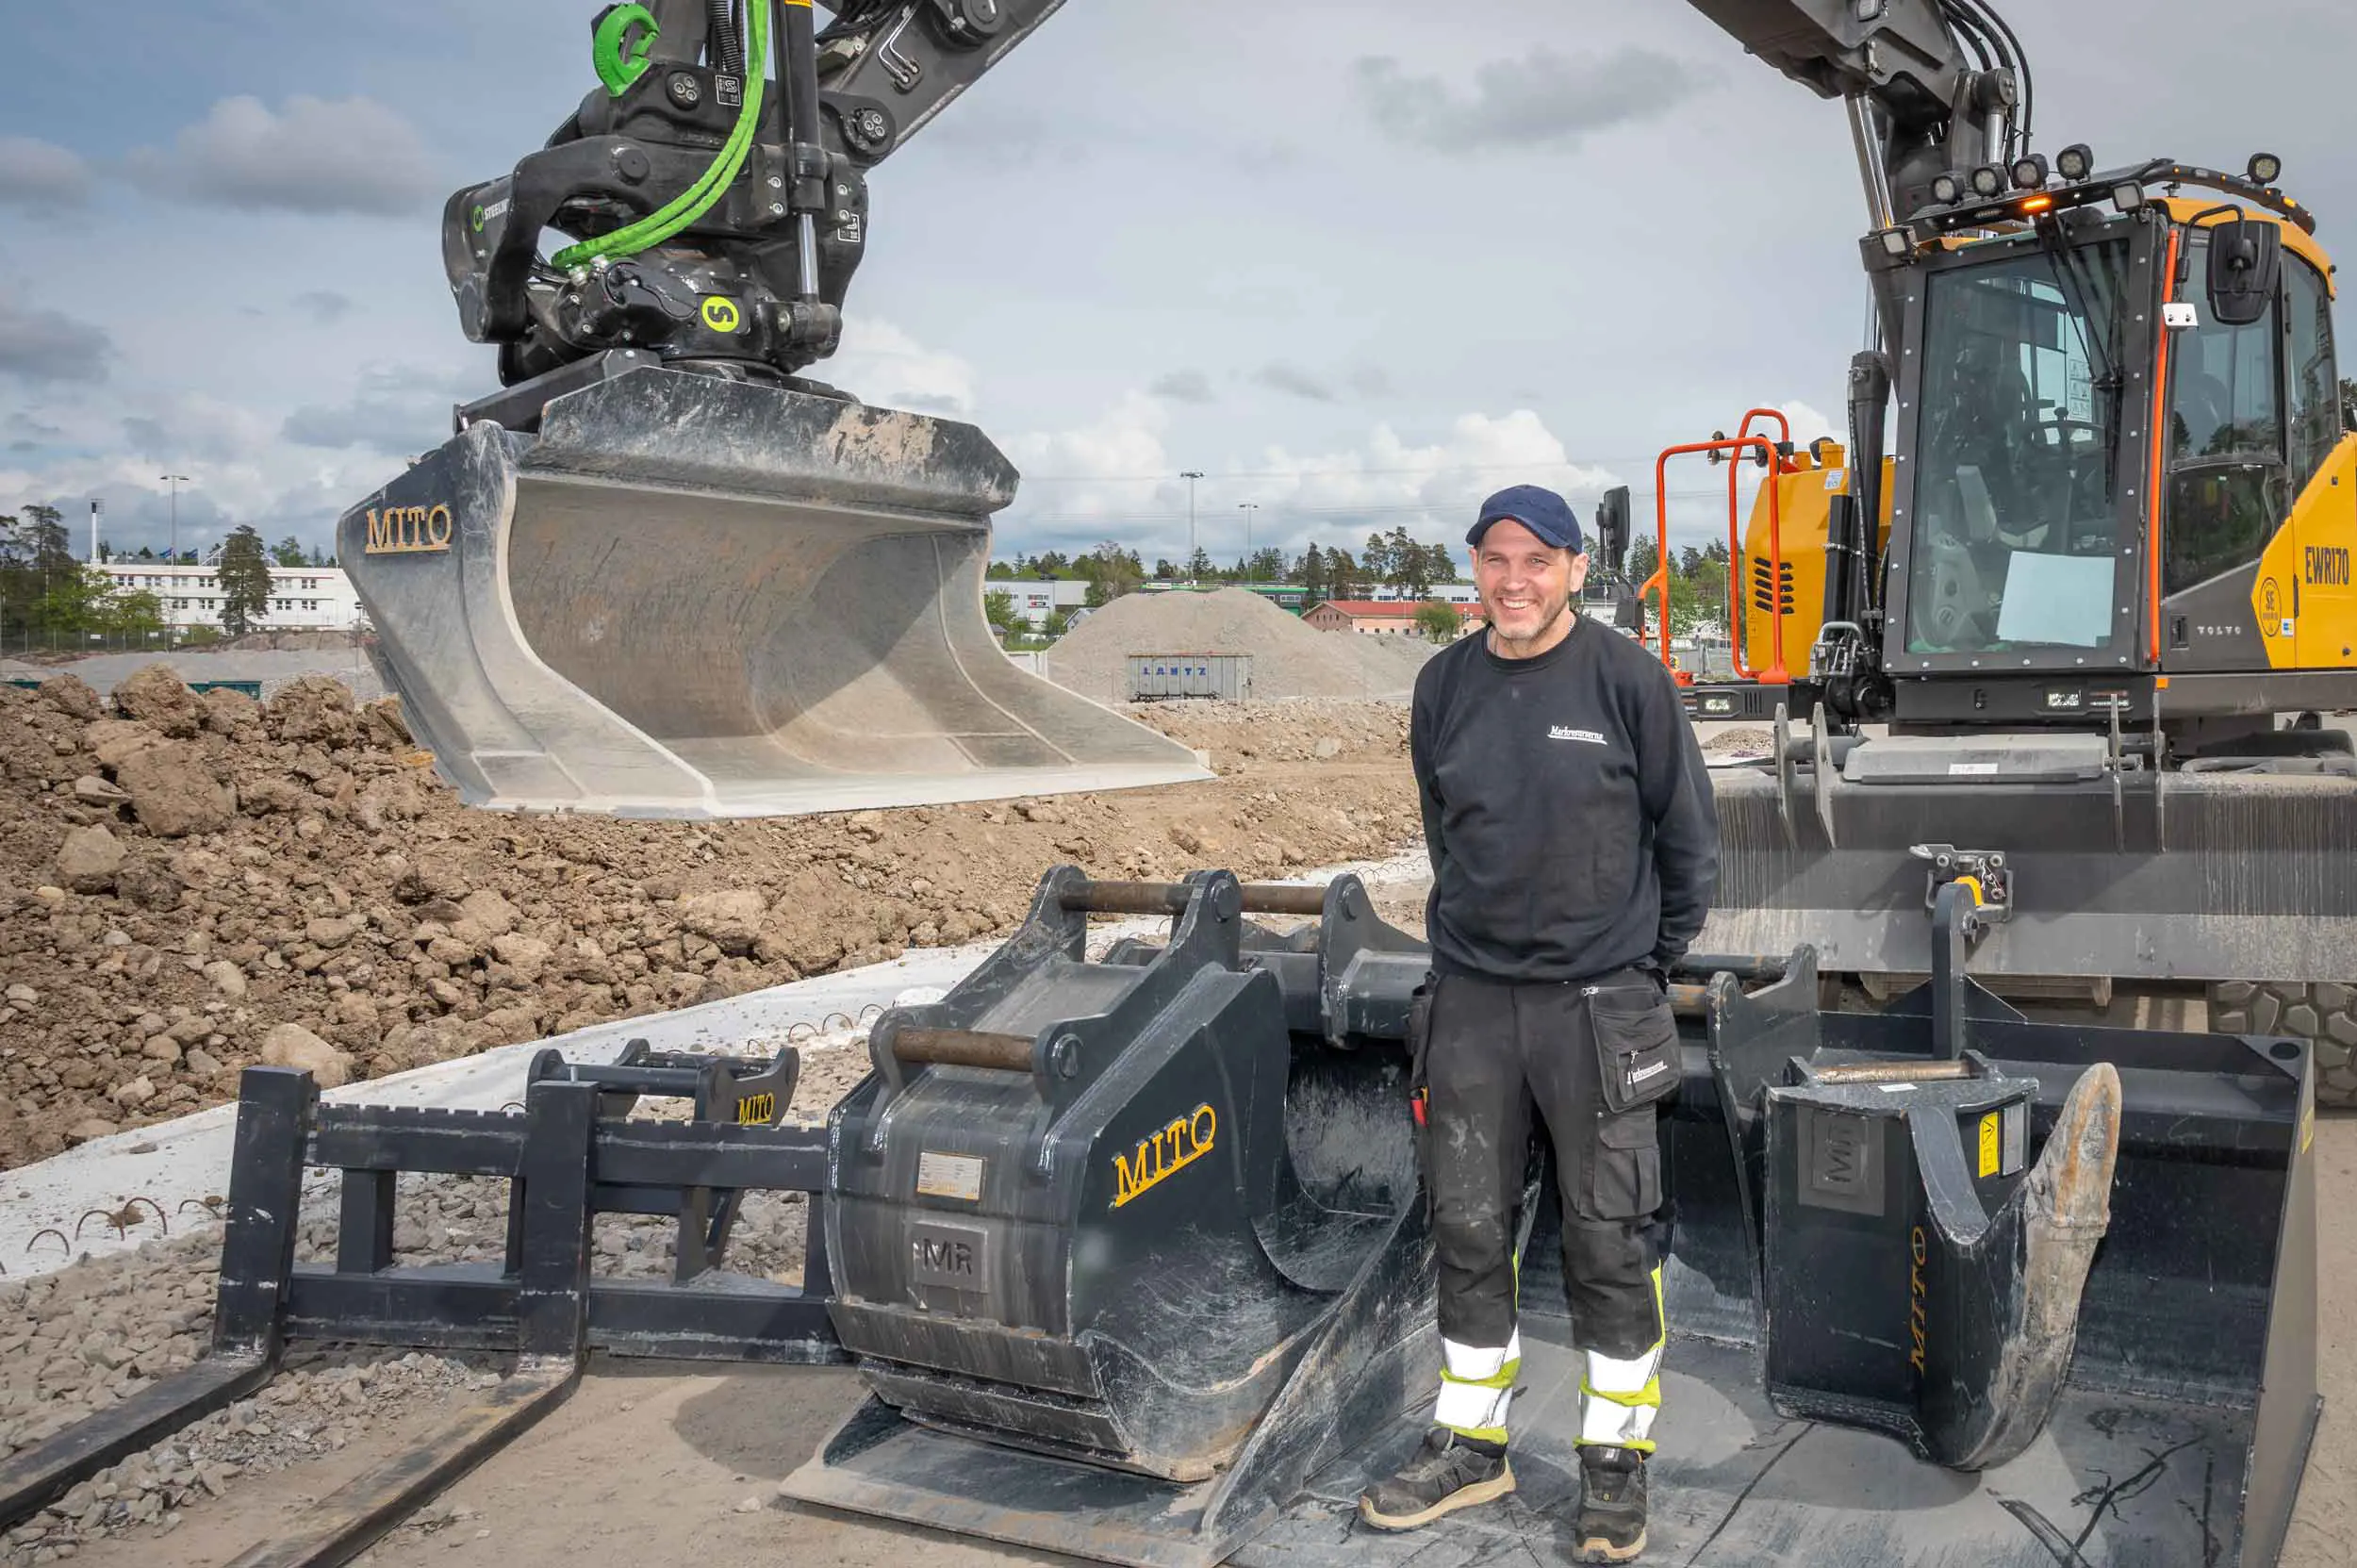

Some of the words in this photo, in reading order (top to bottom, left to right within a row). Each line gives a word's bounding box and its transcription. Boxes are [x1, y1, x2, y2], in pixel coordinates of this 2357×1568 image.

[365, 503, 453, 554] MITO
[2304, 545, 2349, 586] EWR170
[2197, 625, 2242, 635] VOLVO
[738, 1092, 774, 1126] MITO
[1114, 1103, 1216, 1208] MITO
[921, 1236, 973, 1275] MR
[1910, 1225, 1927, 1379] MITO
